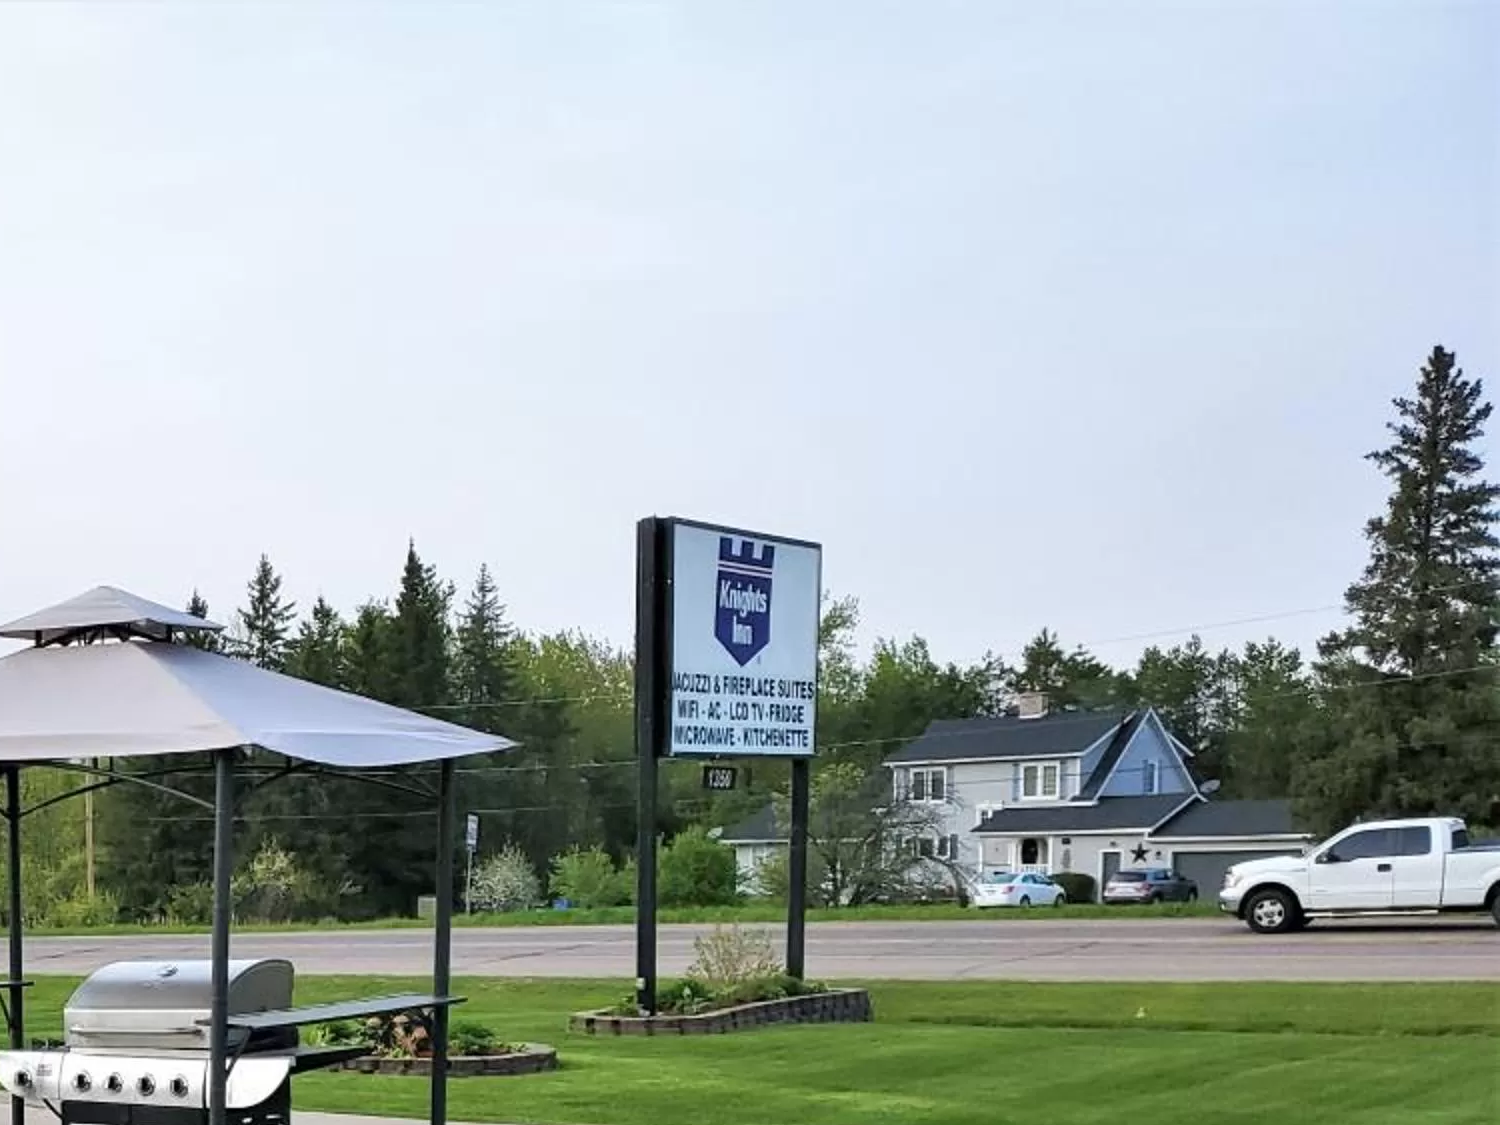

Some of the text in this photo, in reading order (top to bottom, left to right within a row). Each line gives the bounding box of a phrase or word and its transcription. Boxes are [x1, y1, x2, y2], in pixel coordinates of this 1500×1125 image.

[720, 579, 767, 618] Knights
[732, 615, 753, 645] Inn
[713, 674, 720, 694] &
[723, 675, 776, 697] FIREPLACE
[777, 679, 815, 700] SUITES
[678, 700, 699, 719] WIFI
[707, 701, 721, 720] AC
[729, 702, 749, 721] LCD
[674, 725, 735, 746] MICROWAVE
[743, 727, 809, 747] KITCHENETTE
